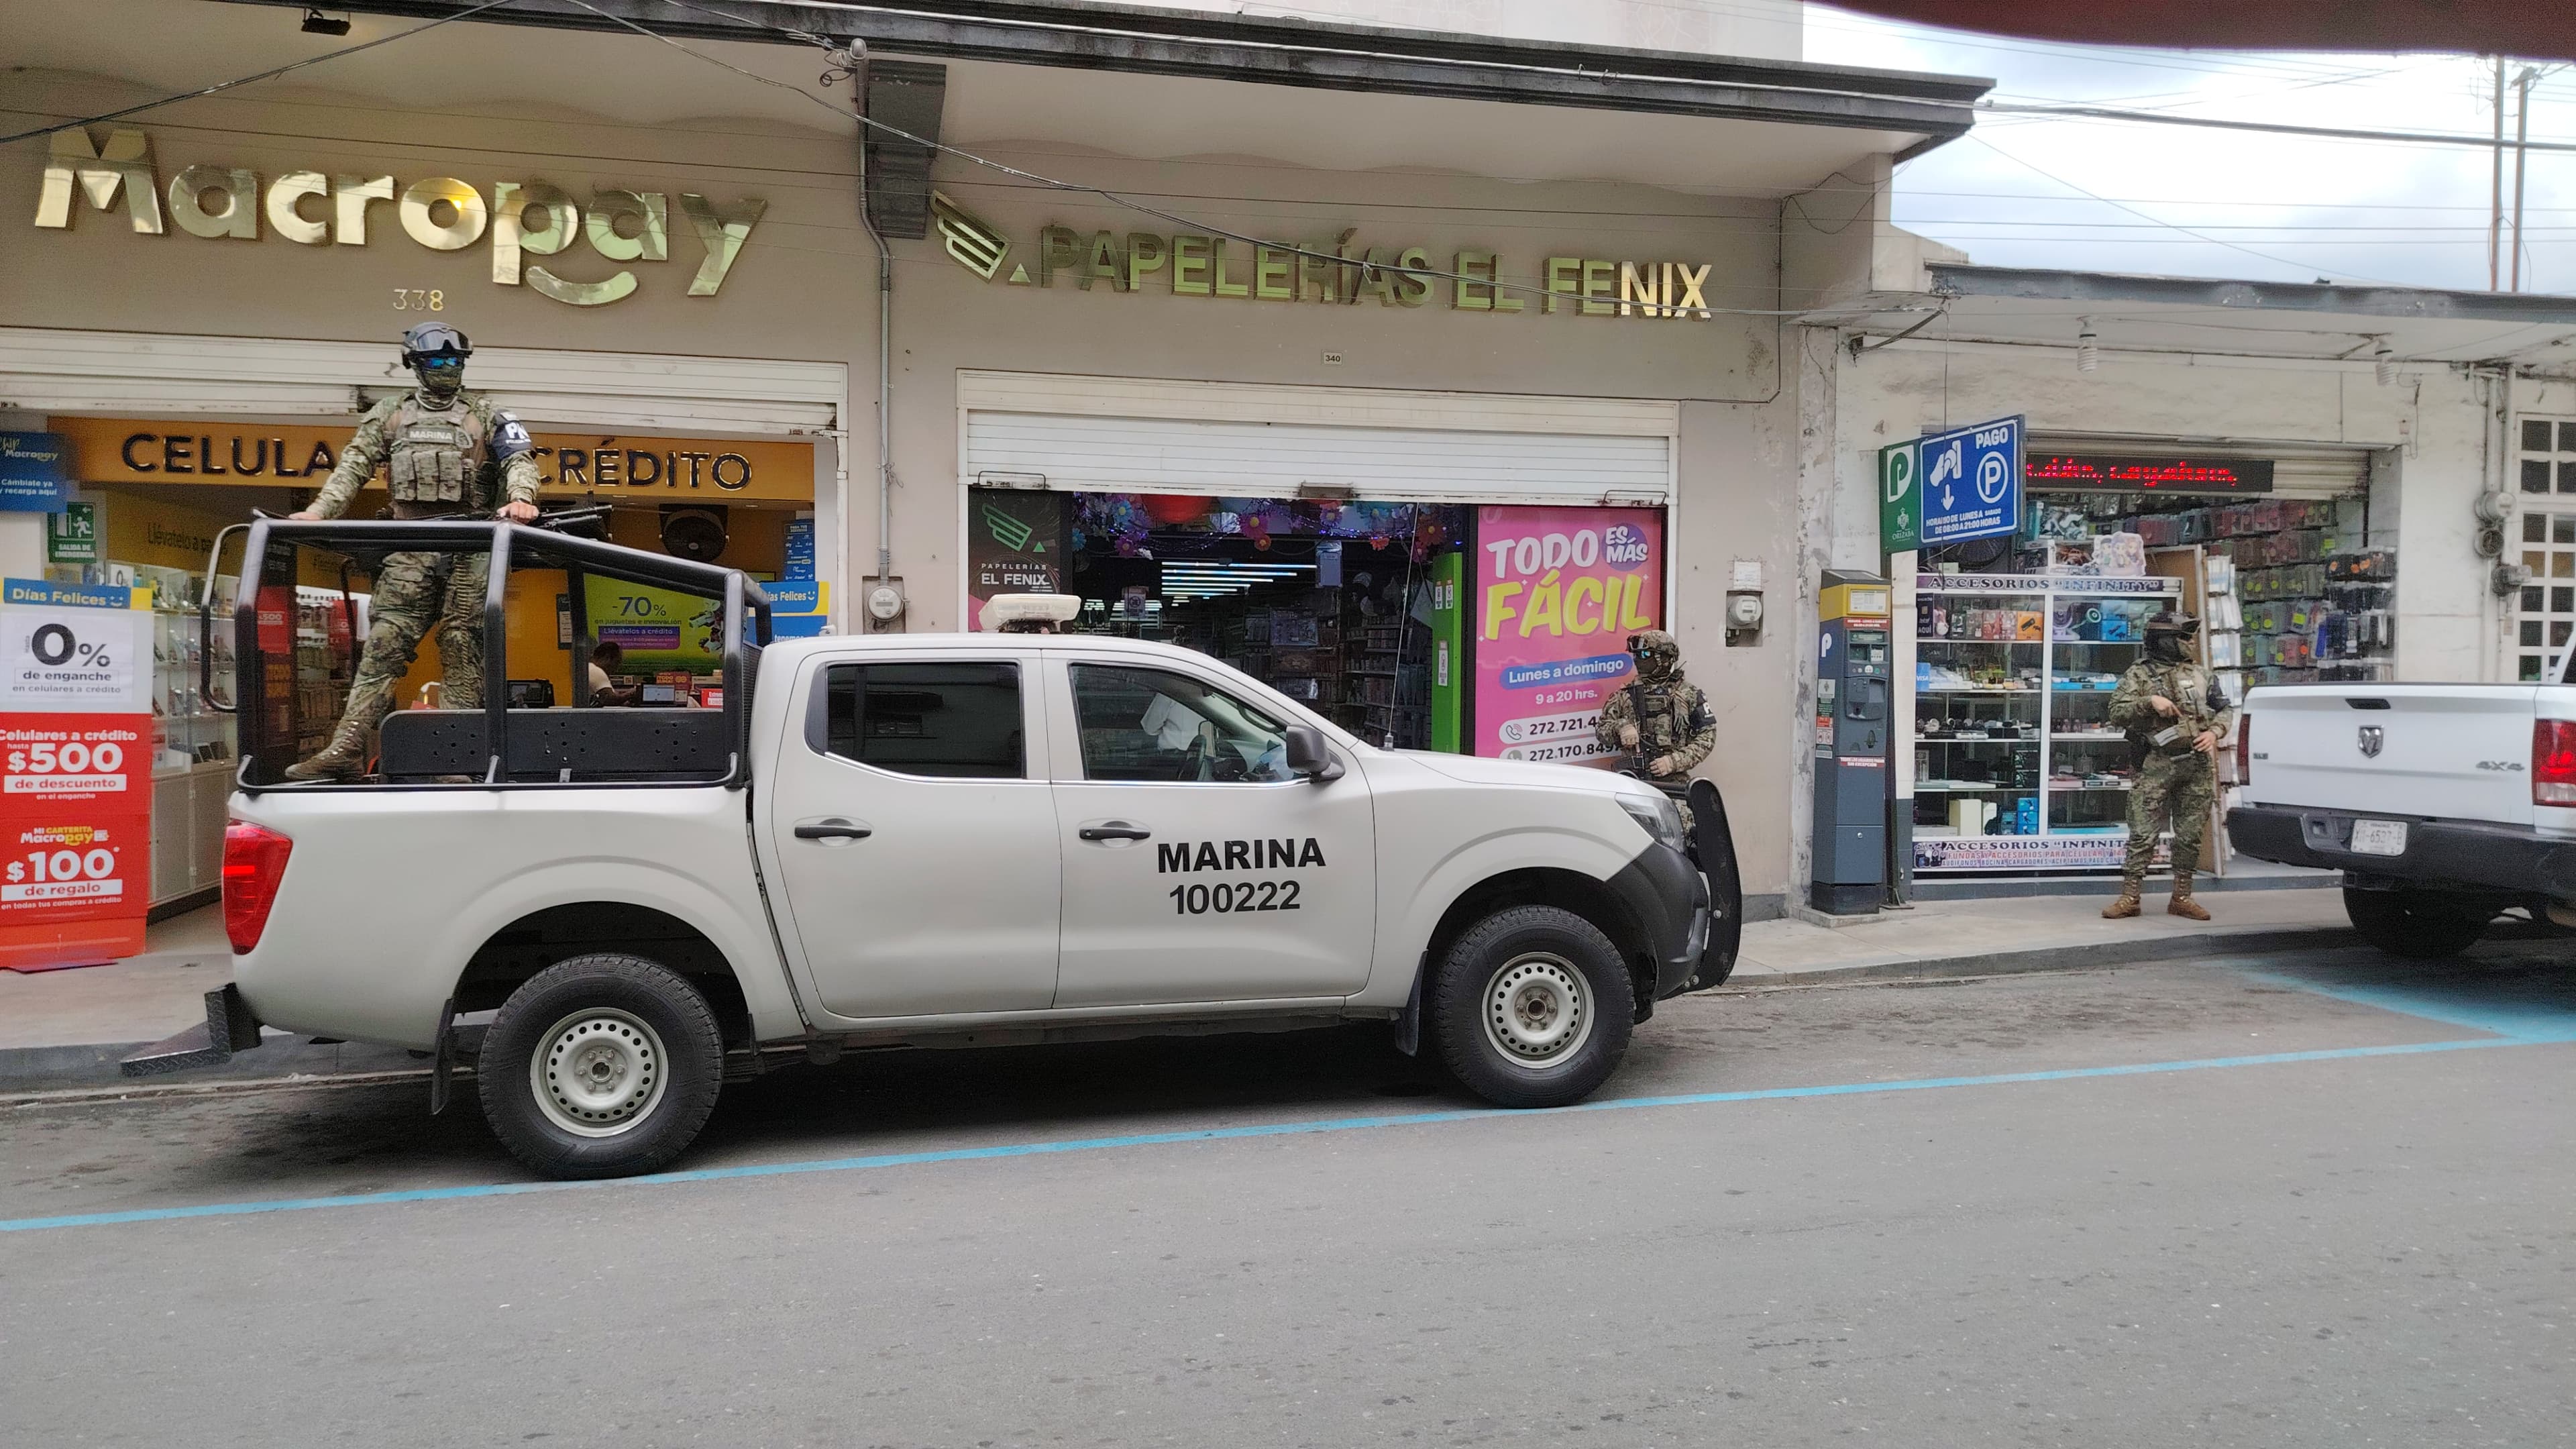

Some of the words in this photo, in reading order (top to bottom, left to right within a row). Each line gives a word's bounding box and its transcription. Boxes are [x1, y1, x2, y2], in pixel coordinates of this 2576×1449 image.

[35, 125, 767, 305] Macropay
[1040, 225, 1434, 307] PAPELERÍAS
[1452, 251, 1524, 313] EL
[1543, 257, 1712, 321] FENIX
[392, 288, 444, 311] 338
[1325, 354, 1341, 362] 340
[410, 431, 452, 440] MARINA
[1976, 427, 2008, 449] PAGO
[5, 450, 58, 462] Macropay
[122, 433, 337, 477] CELULA
[1, 478, 42, 487] Cámbiate
[43, 480, 53, 488] ya
[1985, 460, 2002, 495] P
[5, 488, 36, 496] recarga
[38, 488, 57, 496] aquí
[1951, 514, 1958, 523] DE
[1960, 511, 1978, 521] LUNES
[1978, 510, 1983, 518] A
[1935, 526, 1942, 534] DE
[1980, 517, 2000, 527] HORAS
[1606, 526, 1628, 545] ES
[1486, 529, 1599, 578] TODO
[1606, 537, 1648, 564] MÁS
[981, 573, 999, 584] EL
[1004, 574, 1047, 585] FENIX
[1929, 577, 2049, 588] ACCESORIOS
[13, 588, 47, 602] Días
[52, 590, 106, 606] Felices
[768, 592, 778, 601] ías
[780, 591, 806, 601] Felices
[1485, 568, 1651, 641] FÁCIL
[612, 596, 666, 616] -70%
[647, 627, 673, 635] crédito
[32, 623, 110, 667] 0%
[23, 671, 40, 680] de
[45, 672, 111, 682] enganche
[1509, 670, 1550, 684] Lunes
[1553, 667, 1562, 678] a
[1564, 659, 1624, 676] domingo
[28, 685, 73, 693] celulares
[1536, 694, 1544, 704] 9
[1546, 694, 1554, 703] a
[1556, 691, 1572, 702] 20
[1575, 690, 1598, 700] hrs.
[1529, 716, 1597, 735] 272.721.4
[0, 729, 67, 741] Celulares
[71, 732, 80, 741] a
[85, 730, 138, 741] crédito
[7, 742, 123, 773] $500
[1529, 743, 1618, 761] 272.170.849
[15, 779, 33, 789] de
[39, 779, 116, 789] descuento
[20, 832, 93, 846] Macropay
[1946, 841, 2049, 851] ACCESORIOS
[2054, 840, 2125, 849] "INFINIT
[1157, 838, 1326, 873] MARINA
[1992, 851, 2042, 859] ACCESORIOS
[25, 886, 44, 896] de
[50, 883, 101, 896] regalo
[1169, 880, 1300, 914] 100222
